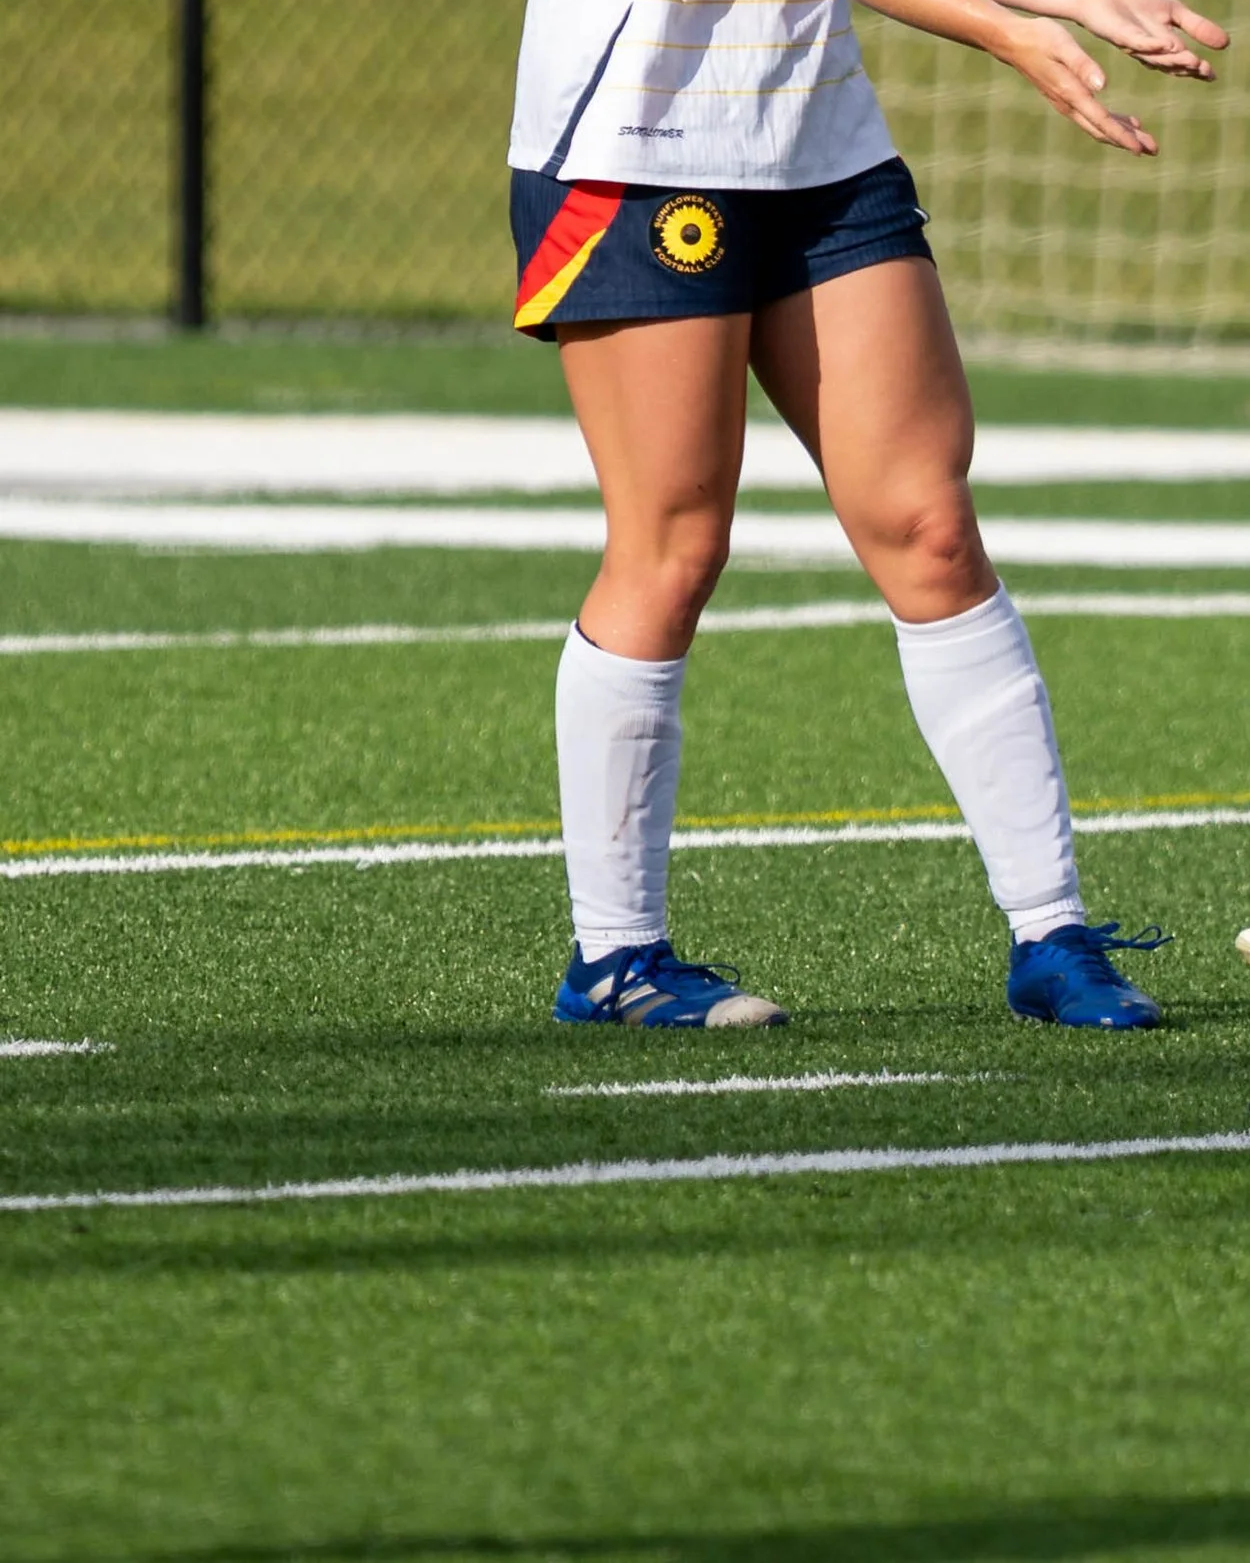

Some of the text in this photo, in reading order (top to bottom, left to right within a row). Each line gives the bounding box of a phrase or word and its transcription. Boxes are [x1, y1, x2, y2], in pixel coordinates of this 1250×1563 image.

[654, 195, 725, 229] SUNFLOWER STATE
[654, 247, 725, 273] FOOTBALL CLUB
